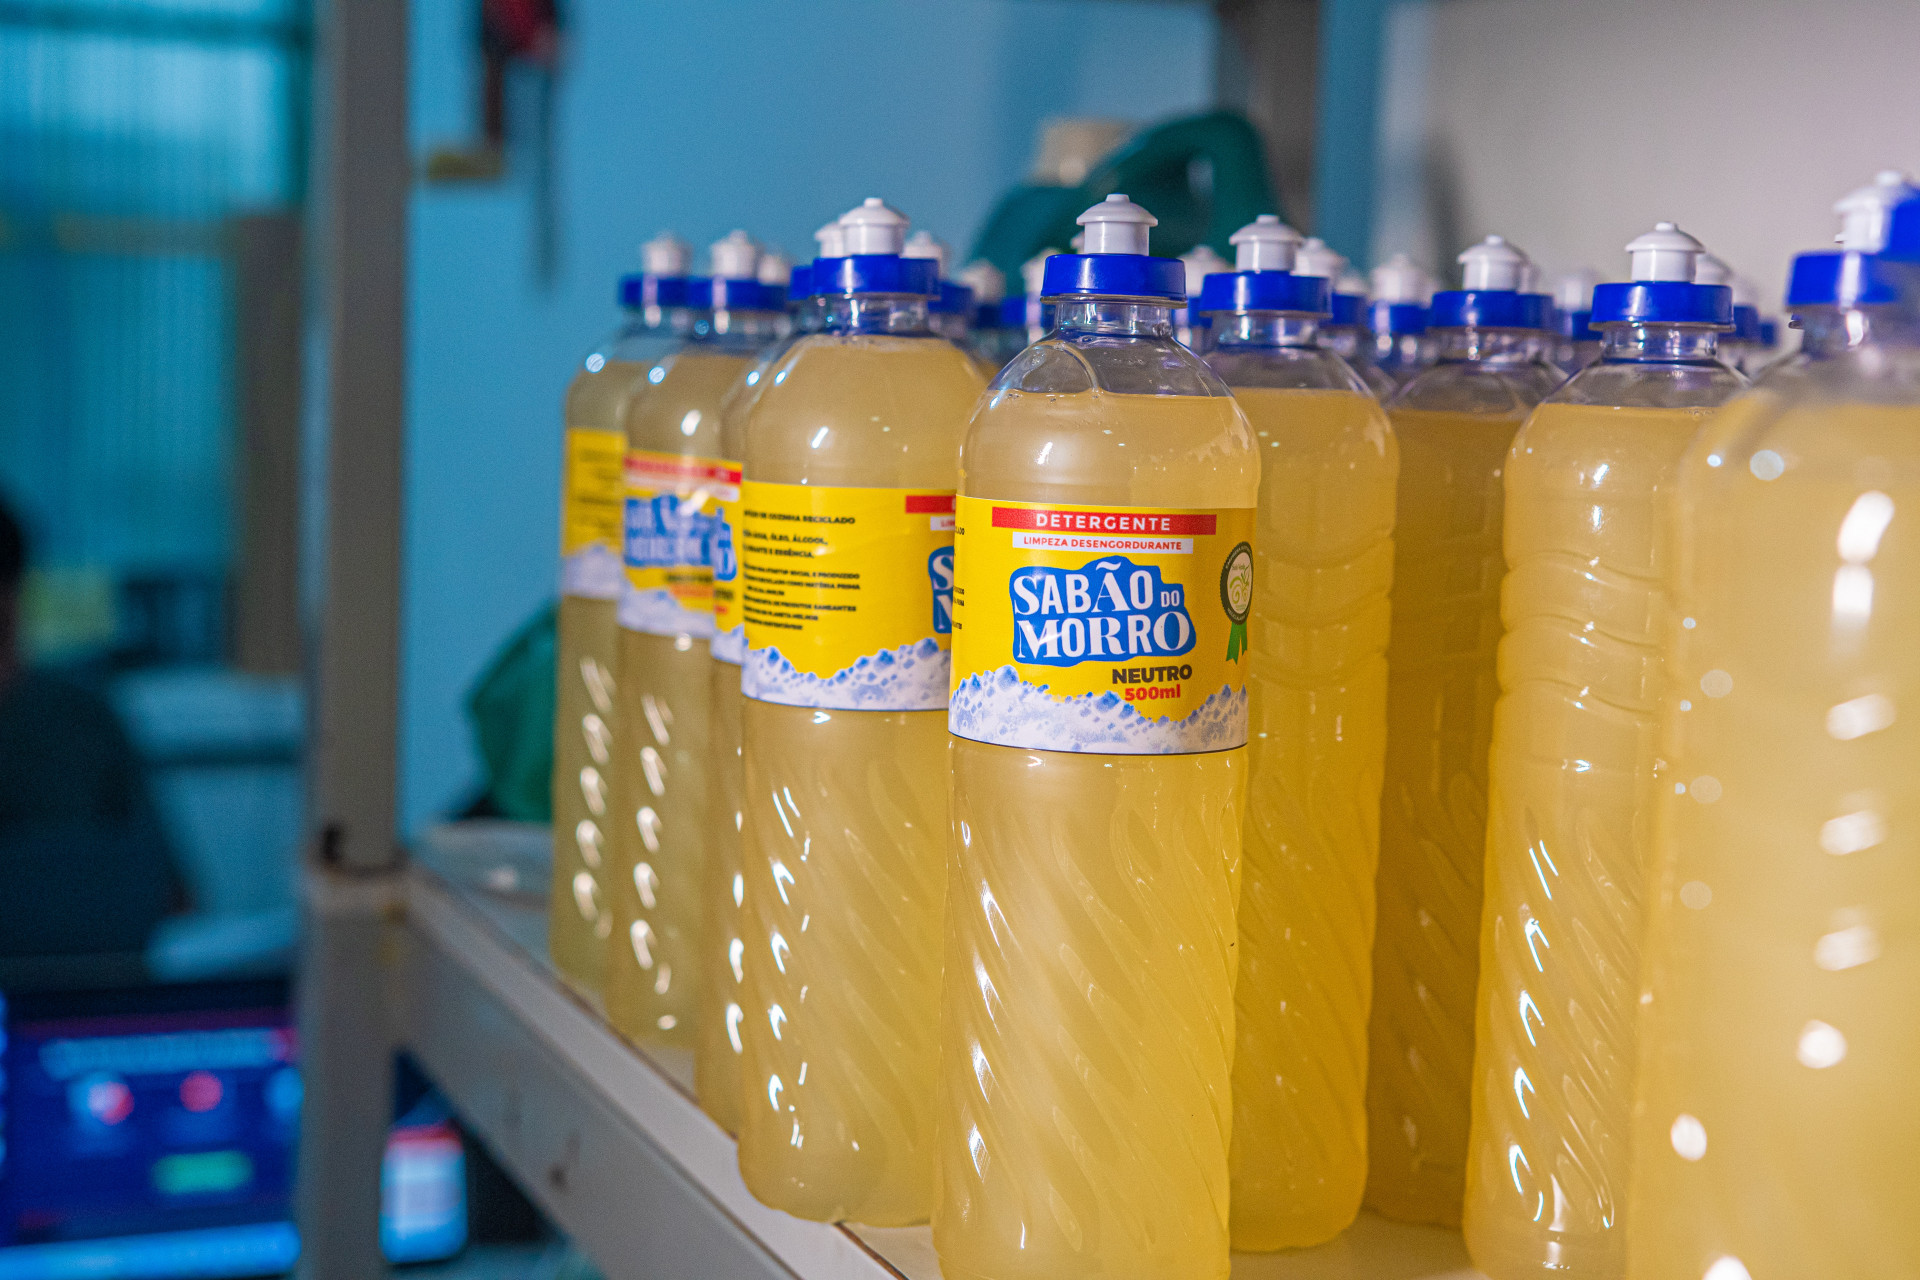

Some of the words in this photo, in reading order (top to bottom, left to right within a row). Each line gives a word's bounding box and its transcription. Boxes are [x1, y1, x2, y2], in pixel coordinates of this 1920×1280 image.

[803, 515, 856, 525] RECICLADO
[1036, 513, 1171, 532] DETERGENTE
[1023, 535, 1068, 548] LIMPEZA
[1071, 538, 1182, 551] DESENGORDURANTE
[1013, 561, 1154, 615] SABÃO
[1160, 590, 1180, 608] DO
[1017, 611, 1190, 659] MORRO
[1112, 664, 1192, 684] NEUTRO
[1124, 684, 1181, 702] 500ml
